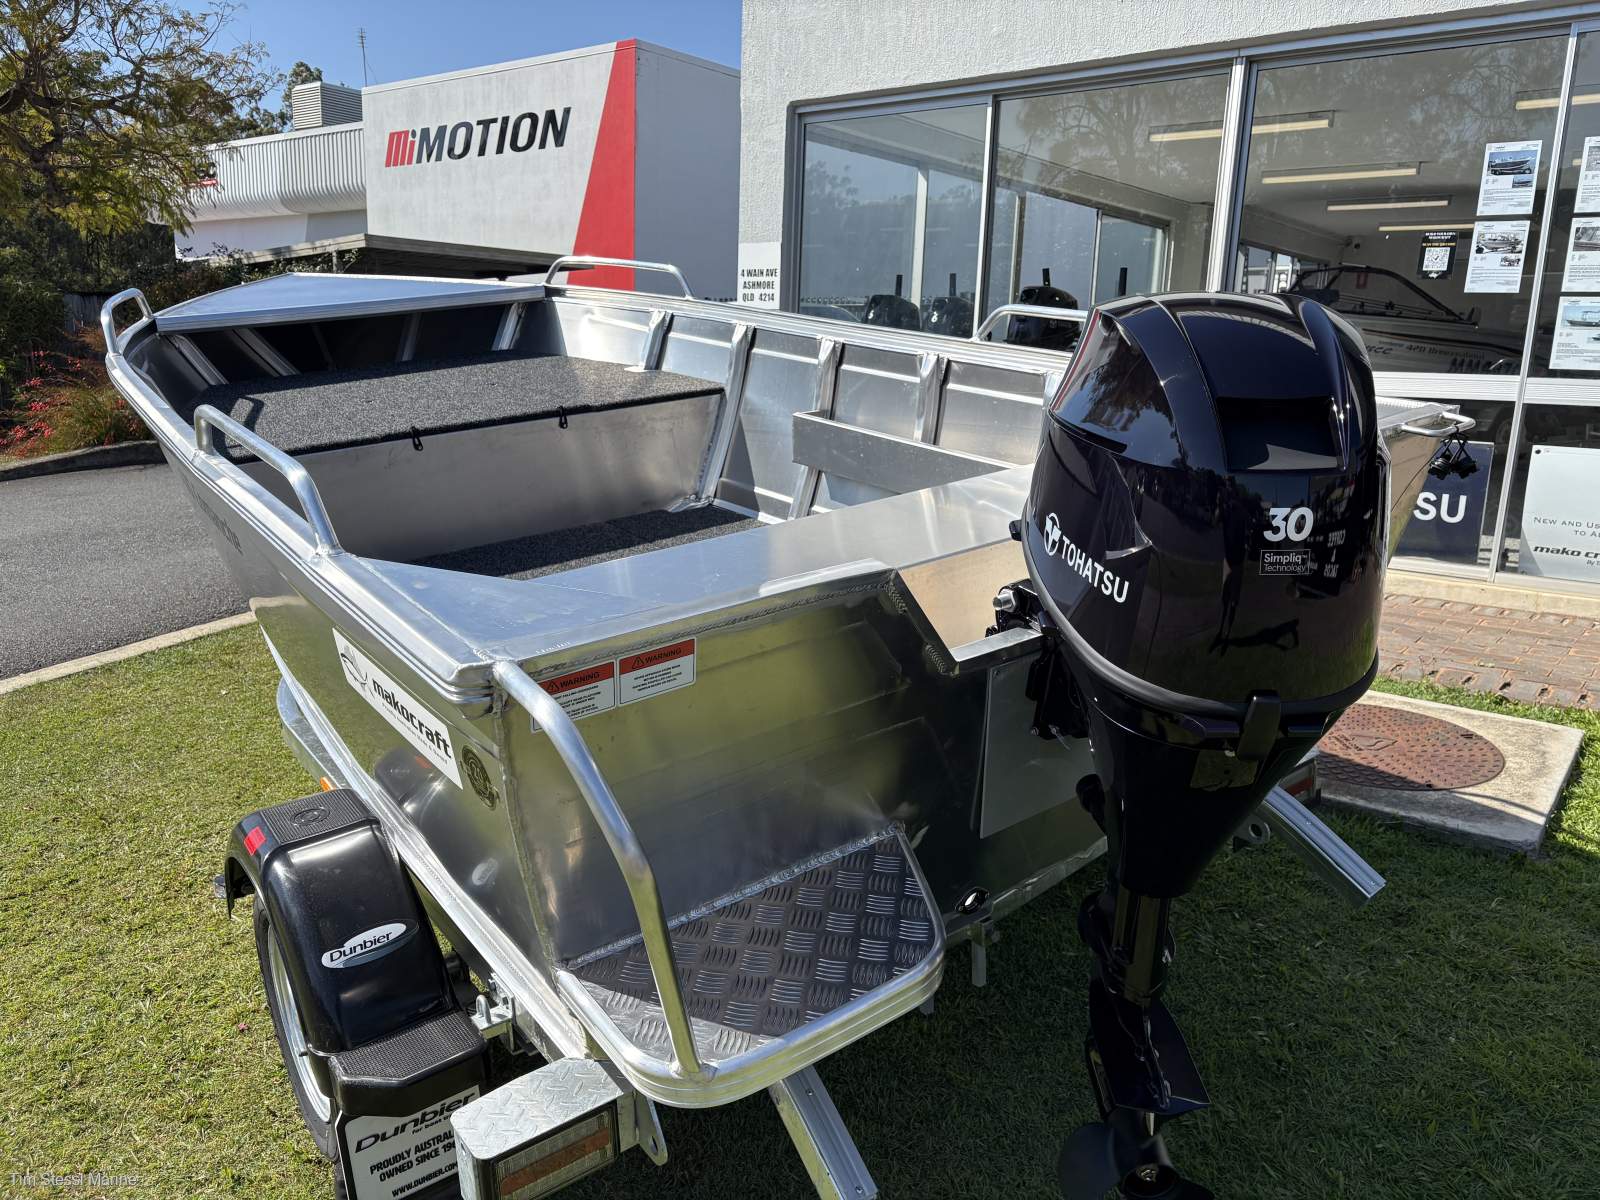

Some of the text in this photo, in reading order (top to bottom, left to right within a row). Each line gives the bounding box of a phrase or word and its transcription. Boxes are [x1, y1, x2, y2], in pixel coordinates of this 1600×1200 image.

[766, 268, 778, 277] AVE
[742, 293, 754, 302] QLD
[743, 281, 775, 290] ASHMORE
[1413, 491, 1467, 523] SU
[1263, 507, 1314, 542] 30
[1533, 516, 1557, 525] NEW
[1533, 546, 1581, 557] mako
[1062, 534, 1129, 603] TOHATSU
[1264, 563, 1307, 574] Technology
[644, 648, 682, 663] WARNING
[560, 672, 600, 689] WARNING
[371, 678, 452, 759] makocraft
[330, 931, 393, 963] Dunbier
[355, 1092, 475, 1153] Dunbier
[370, 1130, 454, 1175] PROUDLY AUSTRAL
[380, 1160, 413, 1182] OWNED
[416, 1147, 440, 1166] SINCE
